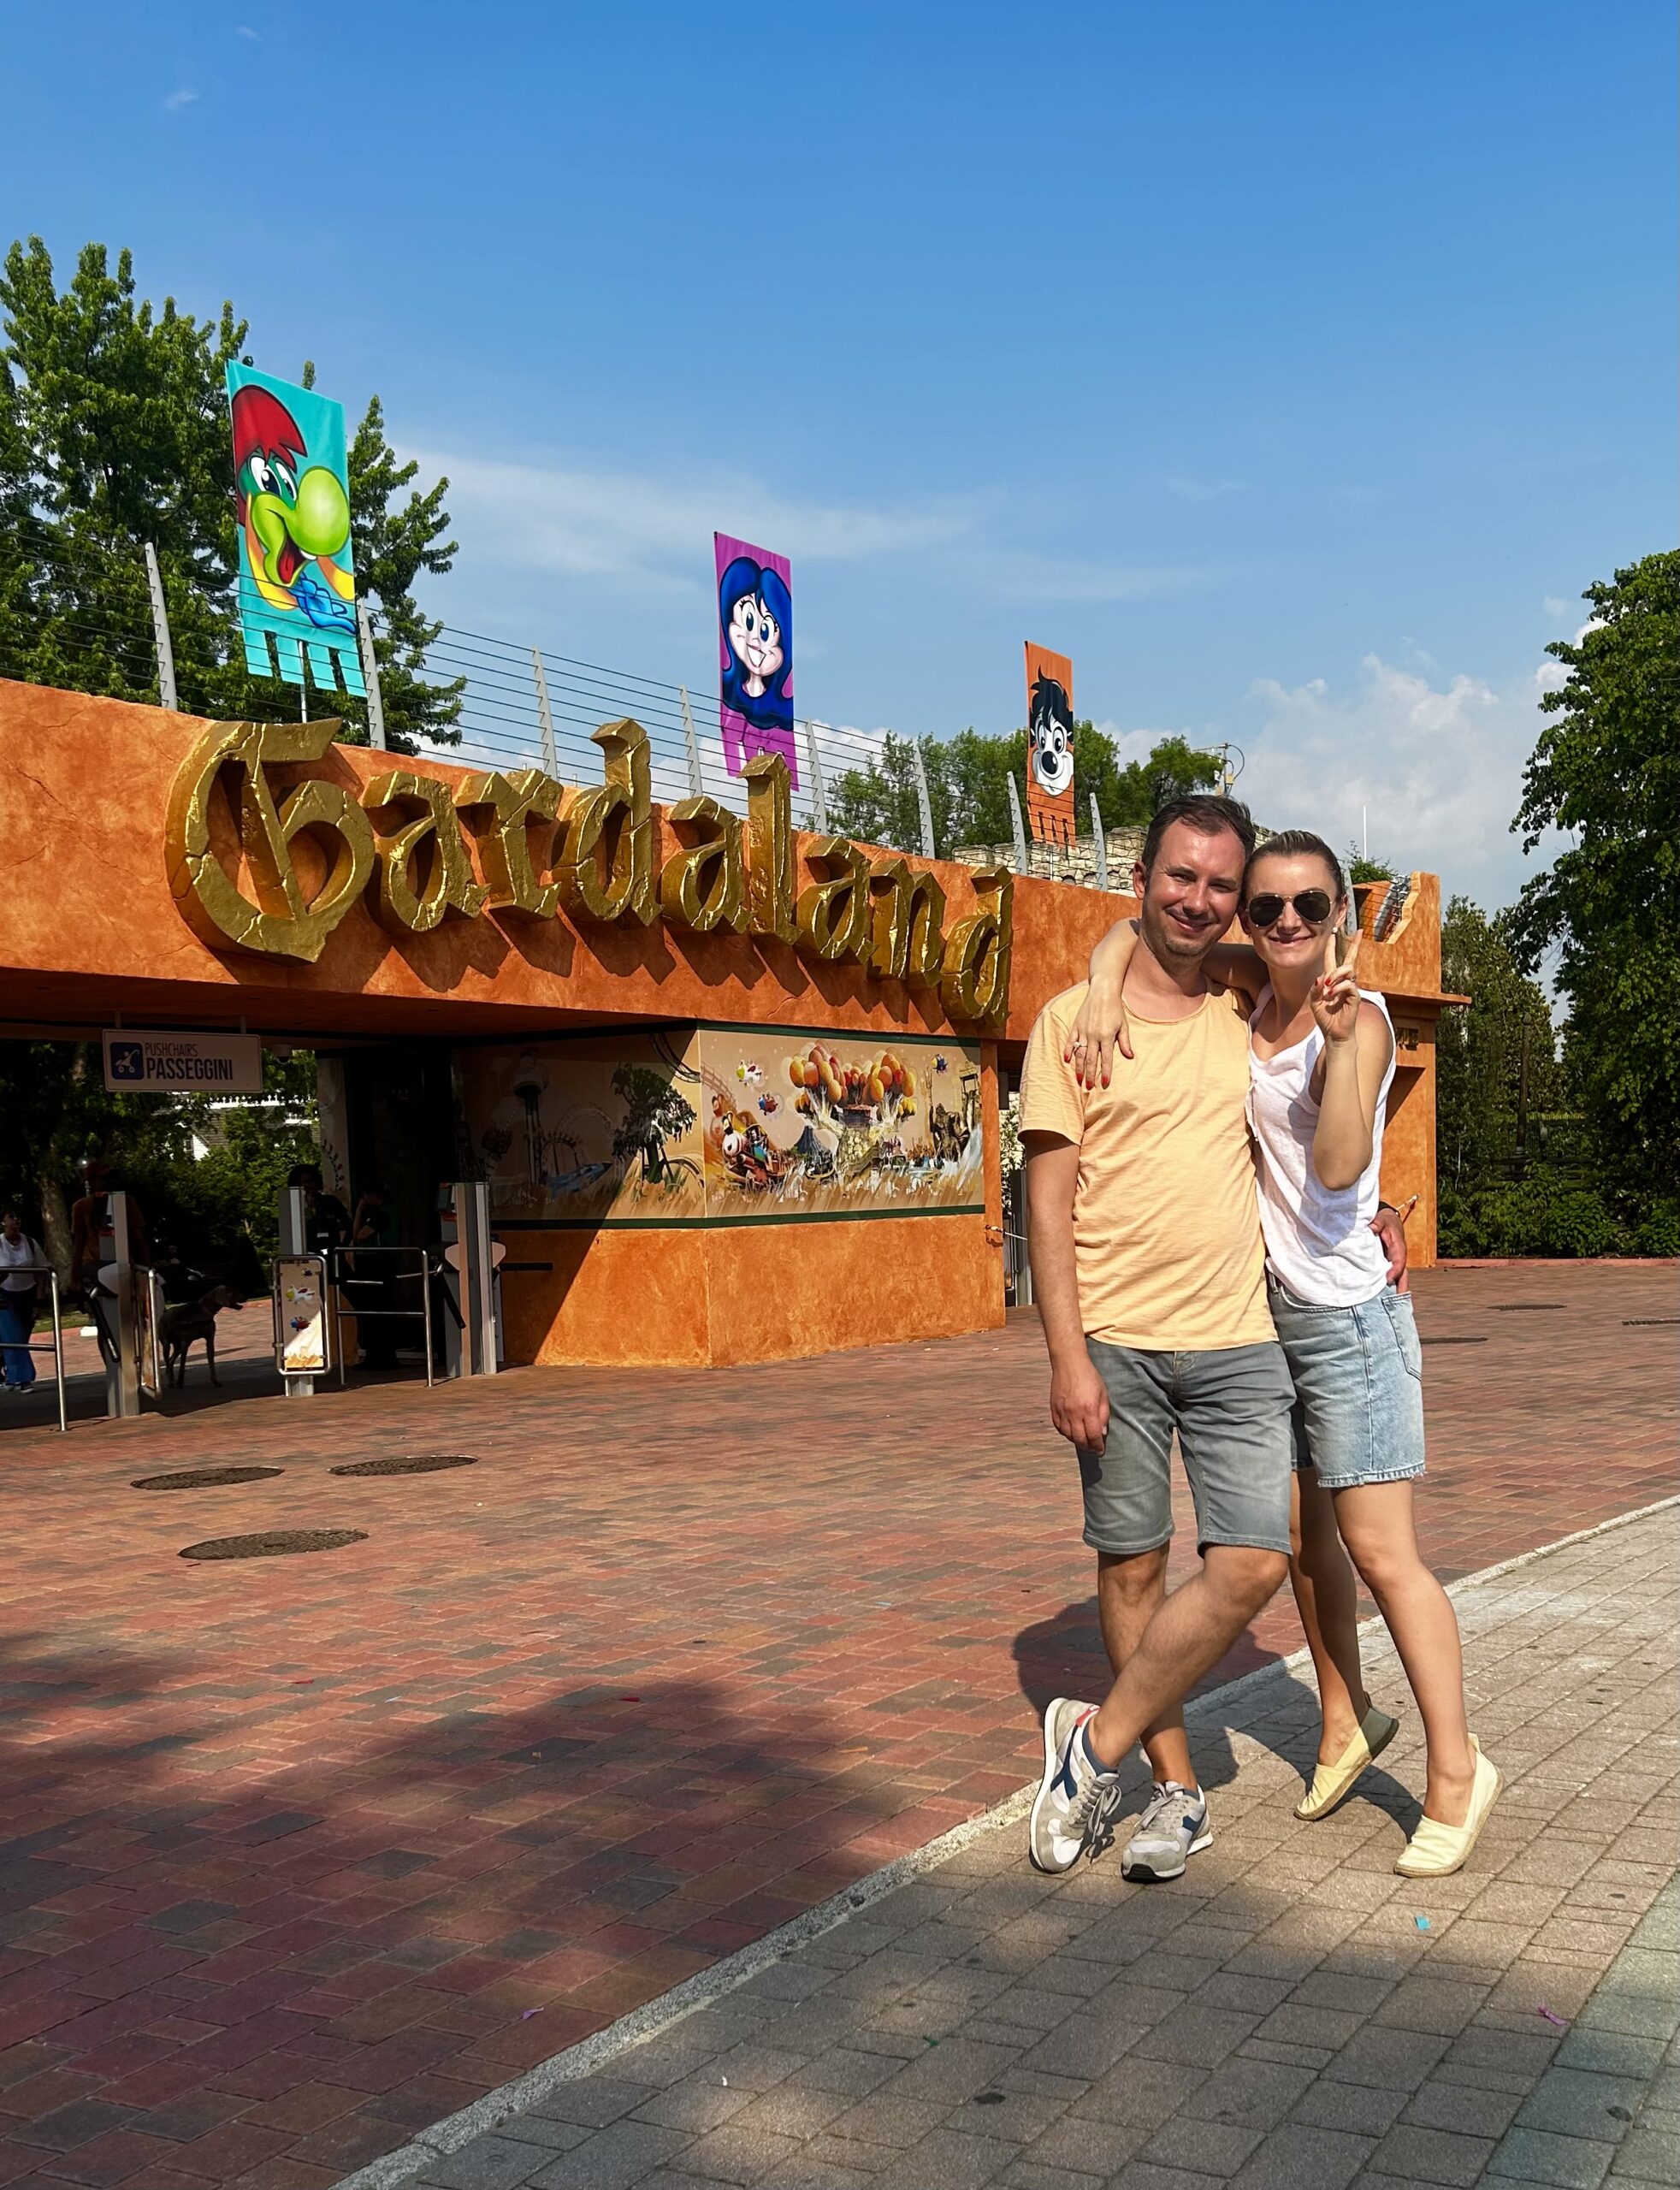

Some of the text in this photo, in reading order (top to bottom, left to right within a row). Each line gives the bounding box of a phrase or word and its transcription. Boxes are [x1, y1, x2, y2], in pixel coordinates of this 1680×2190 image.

[165, 717, 1014, 1026] Gardaland
[145, 1042, 198, 1057] PUSHCHAIRS
[146, 1057, 234, 1080] PASSEGGINI
